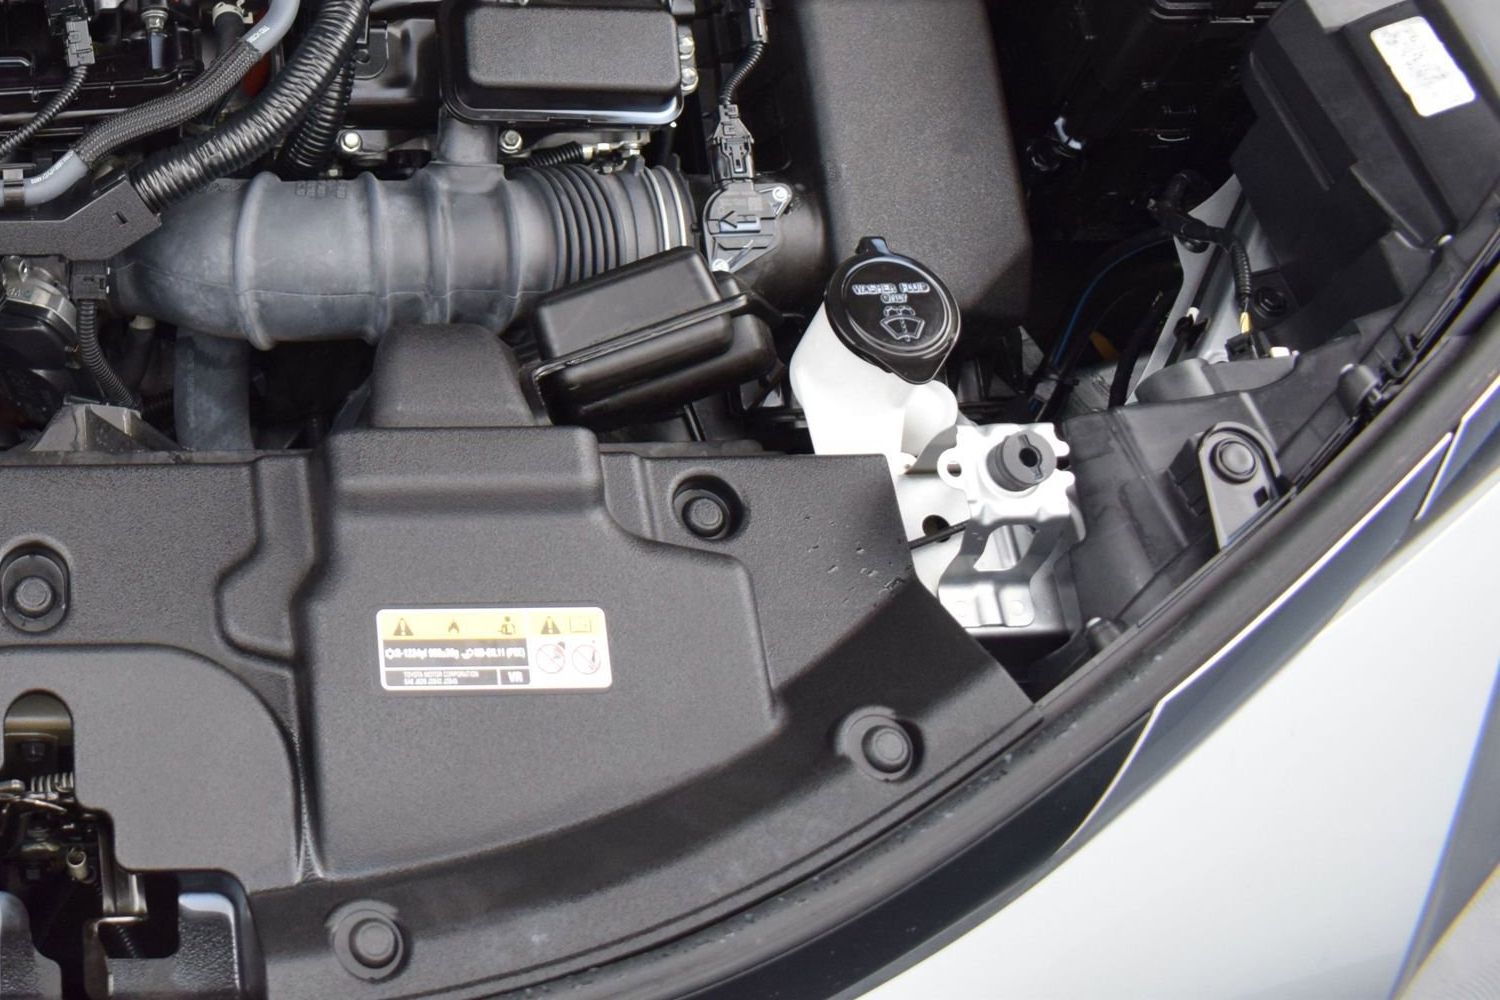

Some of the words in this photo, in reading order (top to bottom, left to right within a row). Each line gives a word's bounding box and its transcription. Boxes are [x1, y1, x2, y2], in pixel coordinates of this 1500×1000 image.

[852, 283, 897, 295] WASHER
[899, 282, 930, 293] FLUID
[880, 294, 908, 303] ONLY
